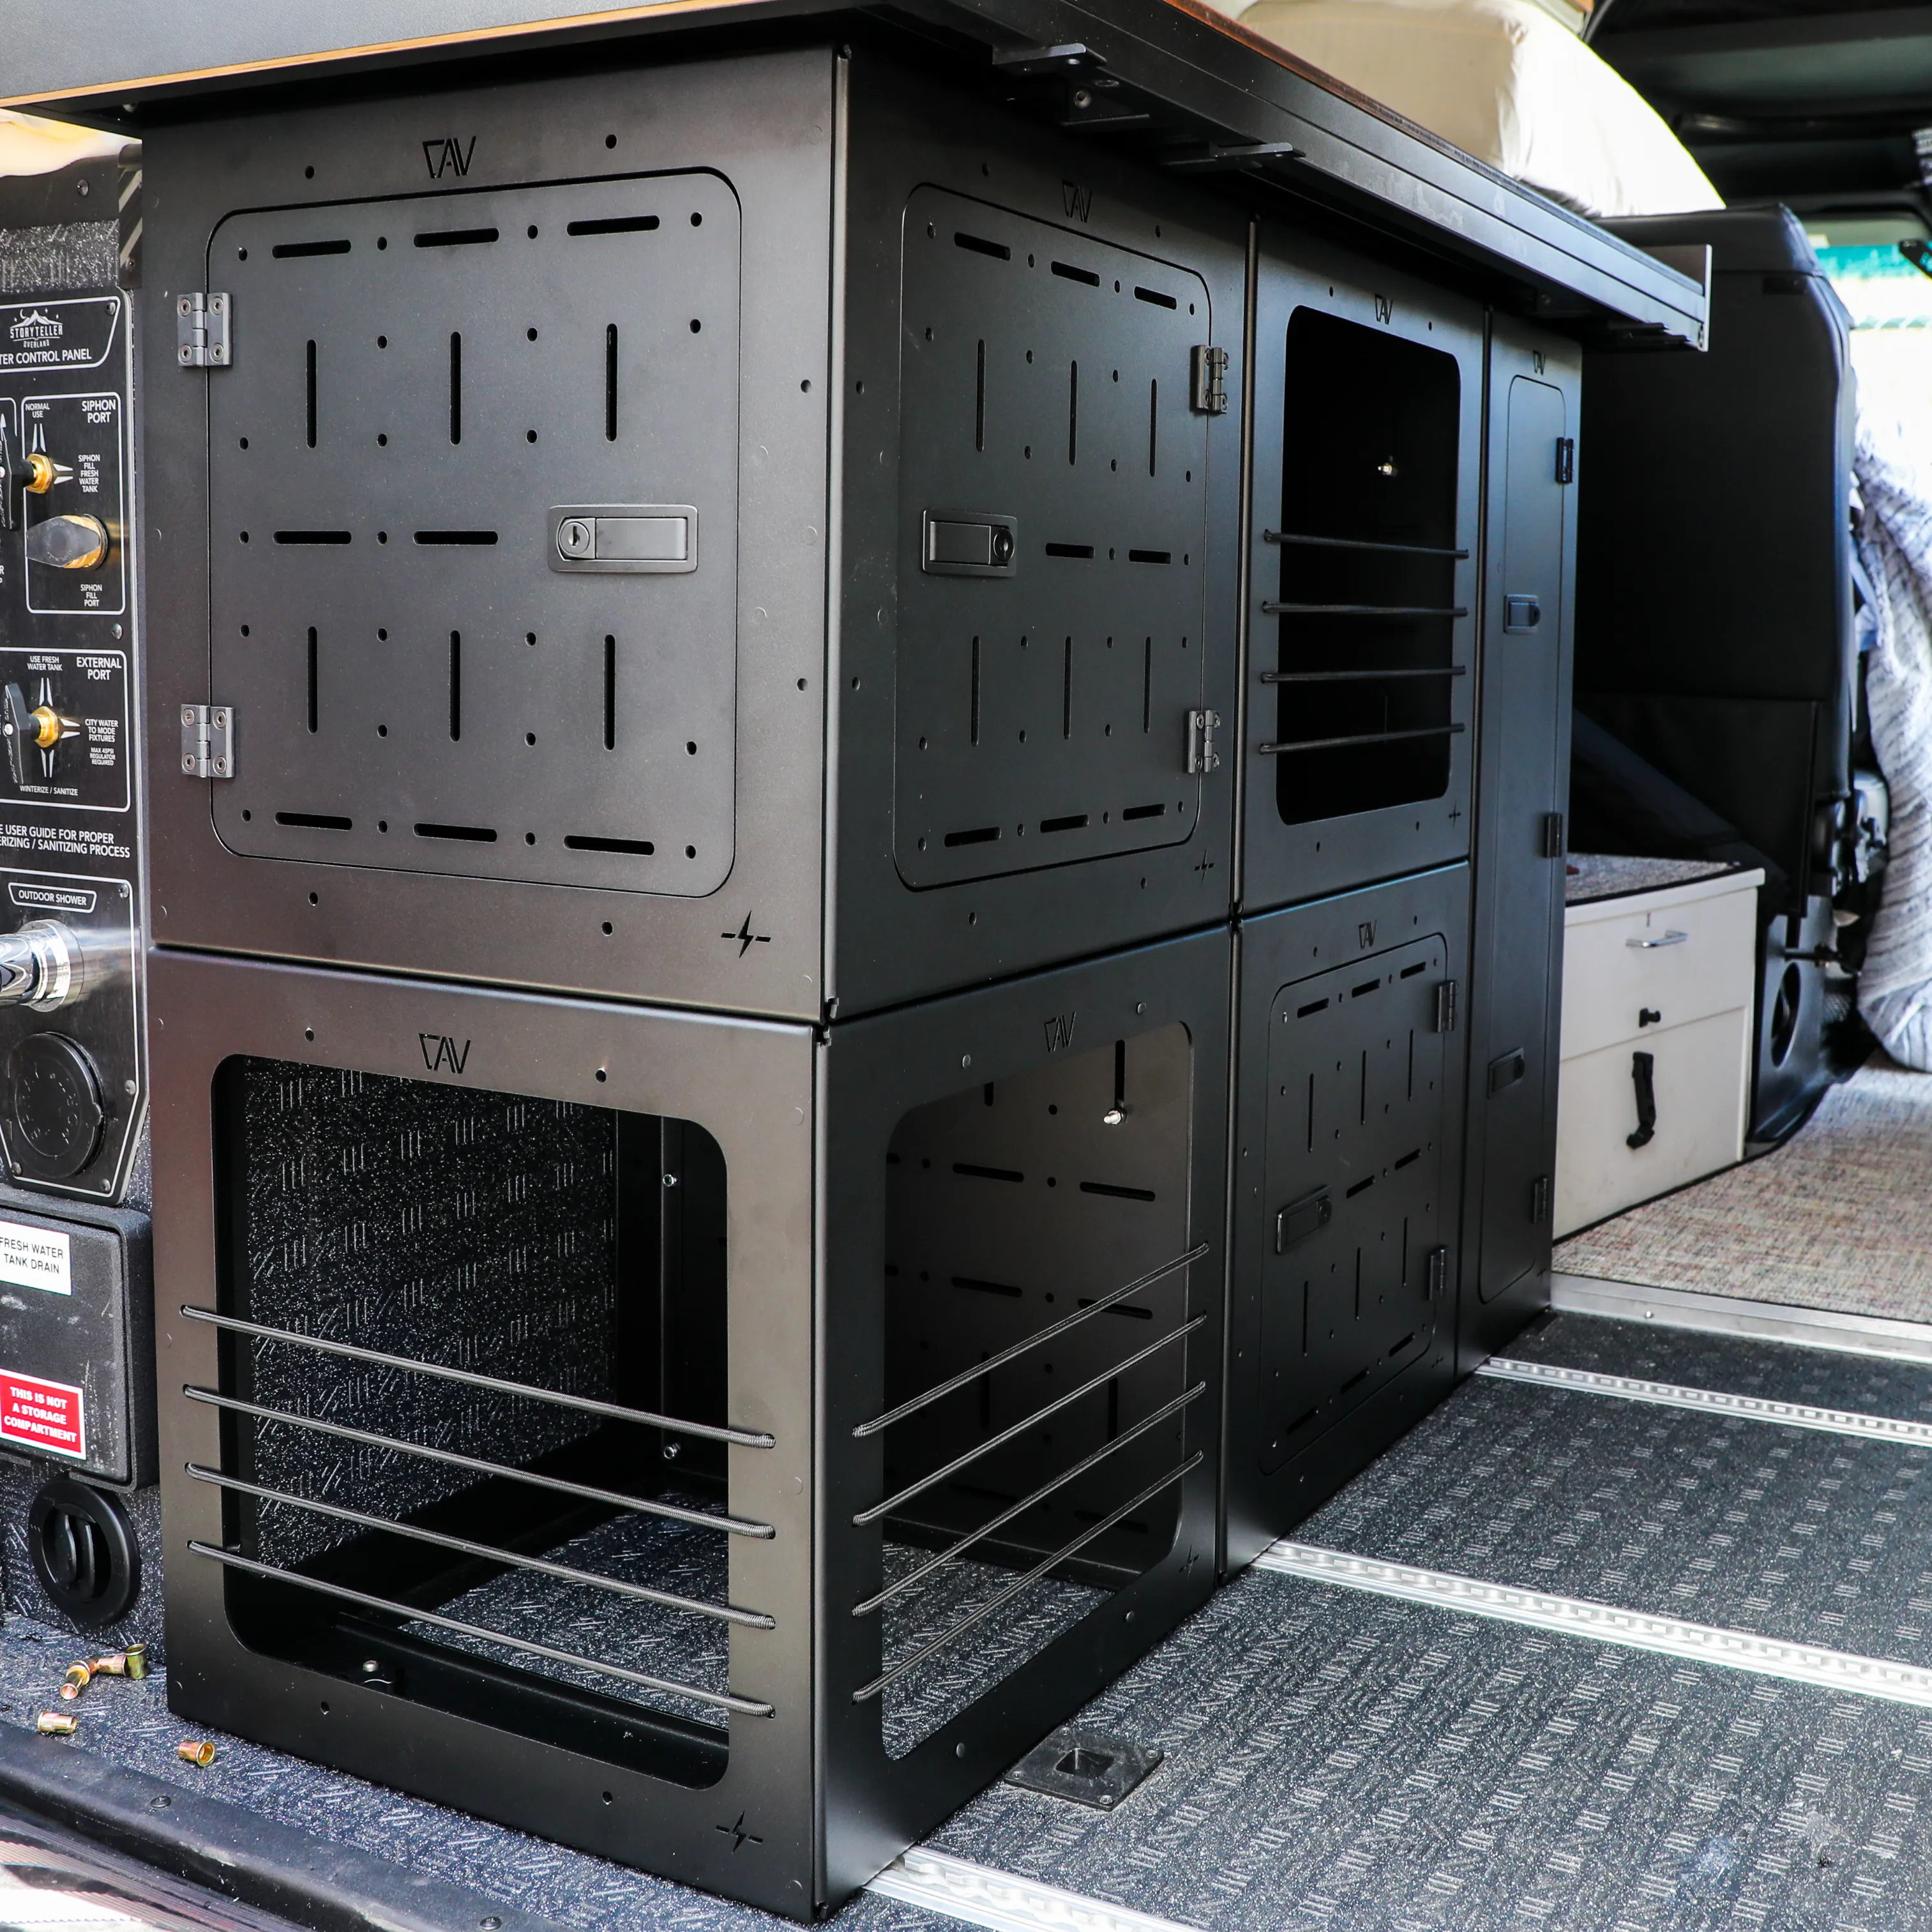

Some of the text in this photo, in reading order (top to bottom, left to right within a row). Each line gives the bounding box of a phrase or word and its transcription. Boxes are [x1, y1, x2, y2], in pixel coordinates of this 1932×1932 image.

[10, 324, 63, 339] STORYTELLER
[23, 339, 50, 349] OVERLAND
[15, 351, 60, 364] CONTROL
[62, 348, 92, 361] PANEL
[82, 399, 116, 412] SIPHON
[87, 412, 111, 423] PORT
[76, 656, 122, 668] EXTERNAL
[87, 669, 111, 681] PORT
[84, 718, 119, 727] CITY WATER
[88, 734, 116, 743] FIXTURES
[97, 727, 116, 735] MODE
[20, 785, 49, 794] WINTERIZE
[53, 787, 79, 796] SANITIZE
[5, 824, 27, 836] USER
[29, 826, 57, 839] GUIDE
[58, 829, 77, 841] FOR
[79, 831, 114, 844] PROPER
[0, 836, 30, 849] RIZING
[38, 839, 87, 854] SANITIZING
[89, 845, 131, 858] PROCESS
[19, 889, 87, 905] OUTDOOR SHOWER
[0, 1237, 63, 1259] FRESH WATER
[4, 1253, 59, 1274] TANK DRAIN
[10, 1386, 67, 1409] THIS IS NOT
[12, 1403, 67, 1424] A STORAGE
[4, 1416, 77, 1443] COMPARTMENT
